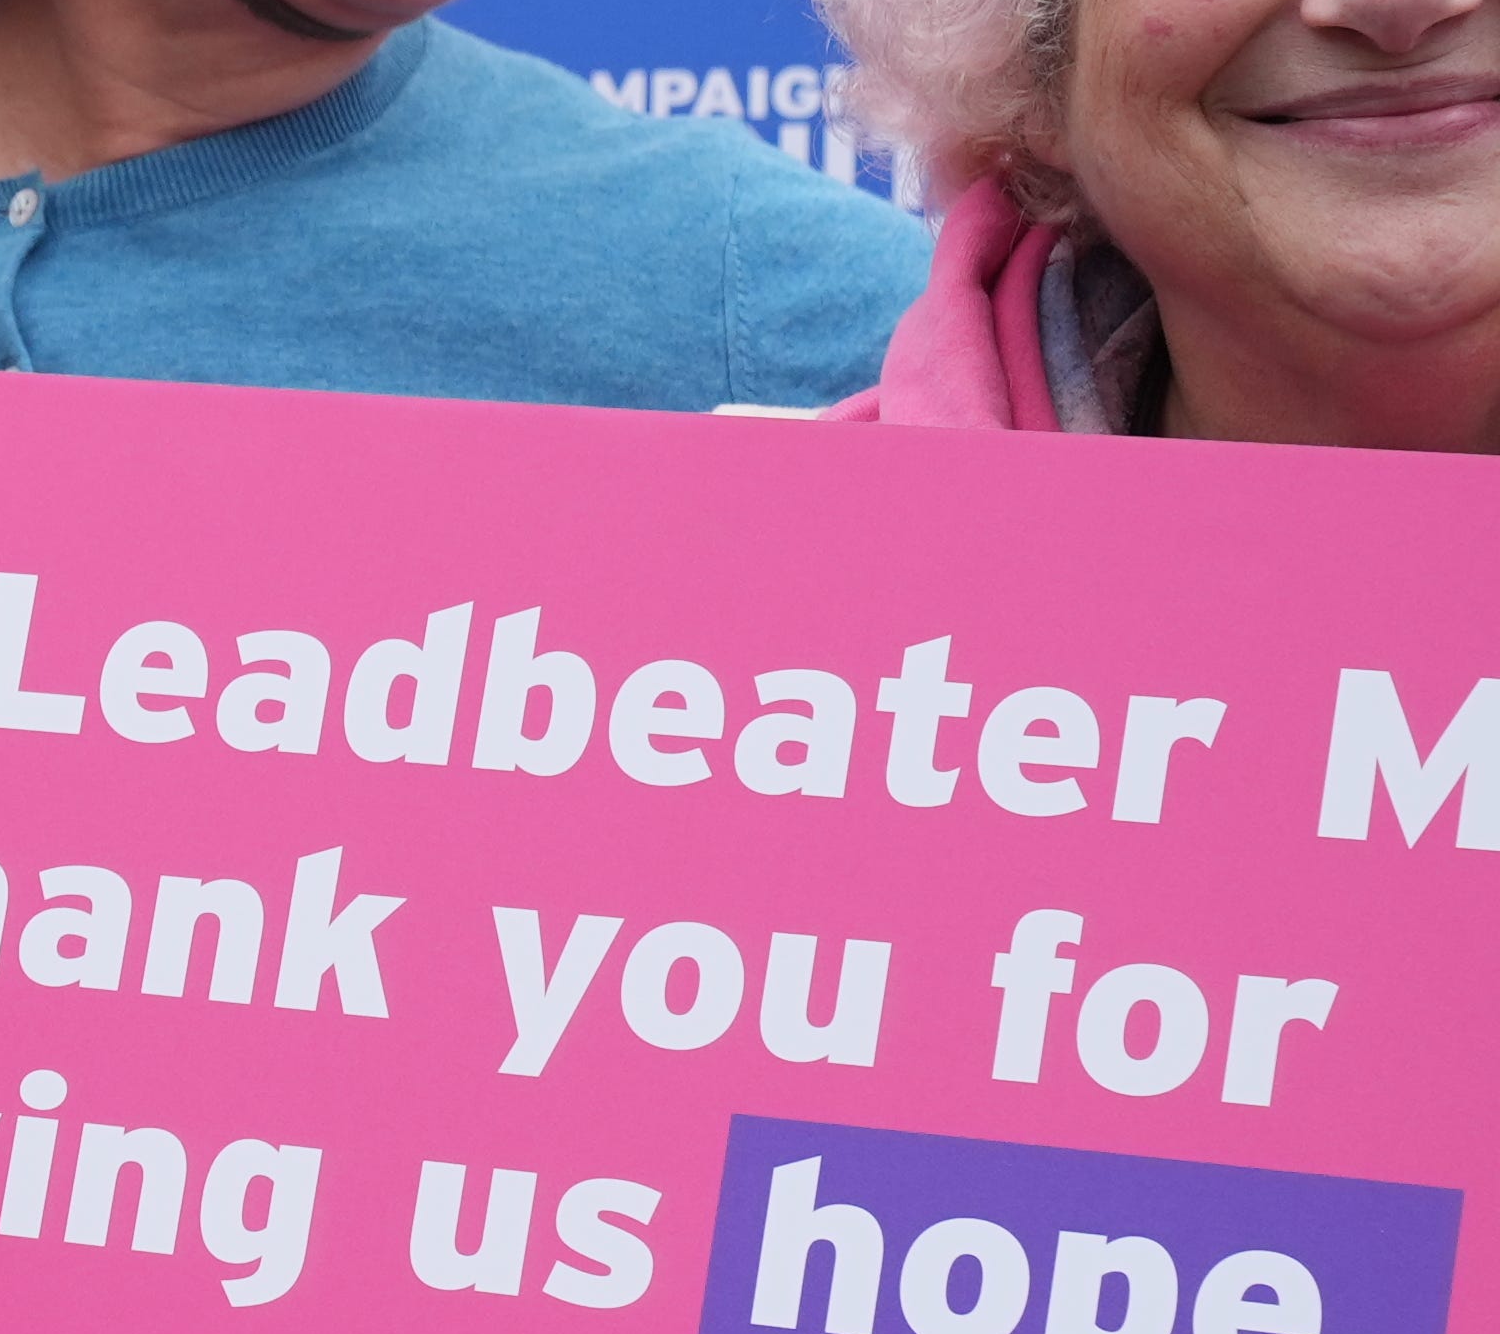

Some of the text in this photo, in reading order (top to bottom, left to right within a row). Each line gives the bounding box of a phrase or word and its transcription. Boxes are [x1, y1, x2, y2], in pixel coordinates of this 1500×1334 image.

[492, 907, 891, 1077] you
[991, 909, 1339, 1106] for
[410, 1161, 662, 1308] us
